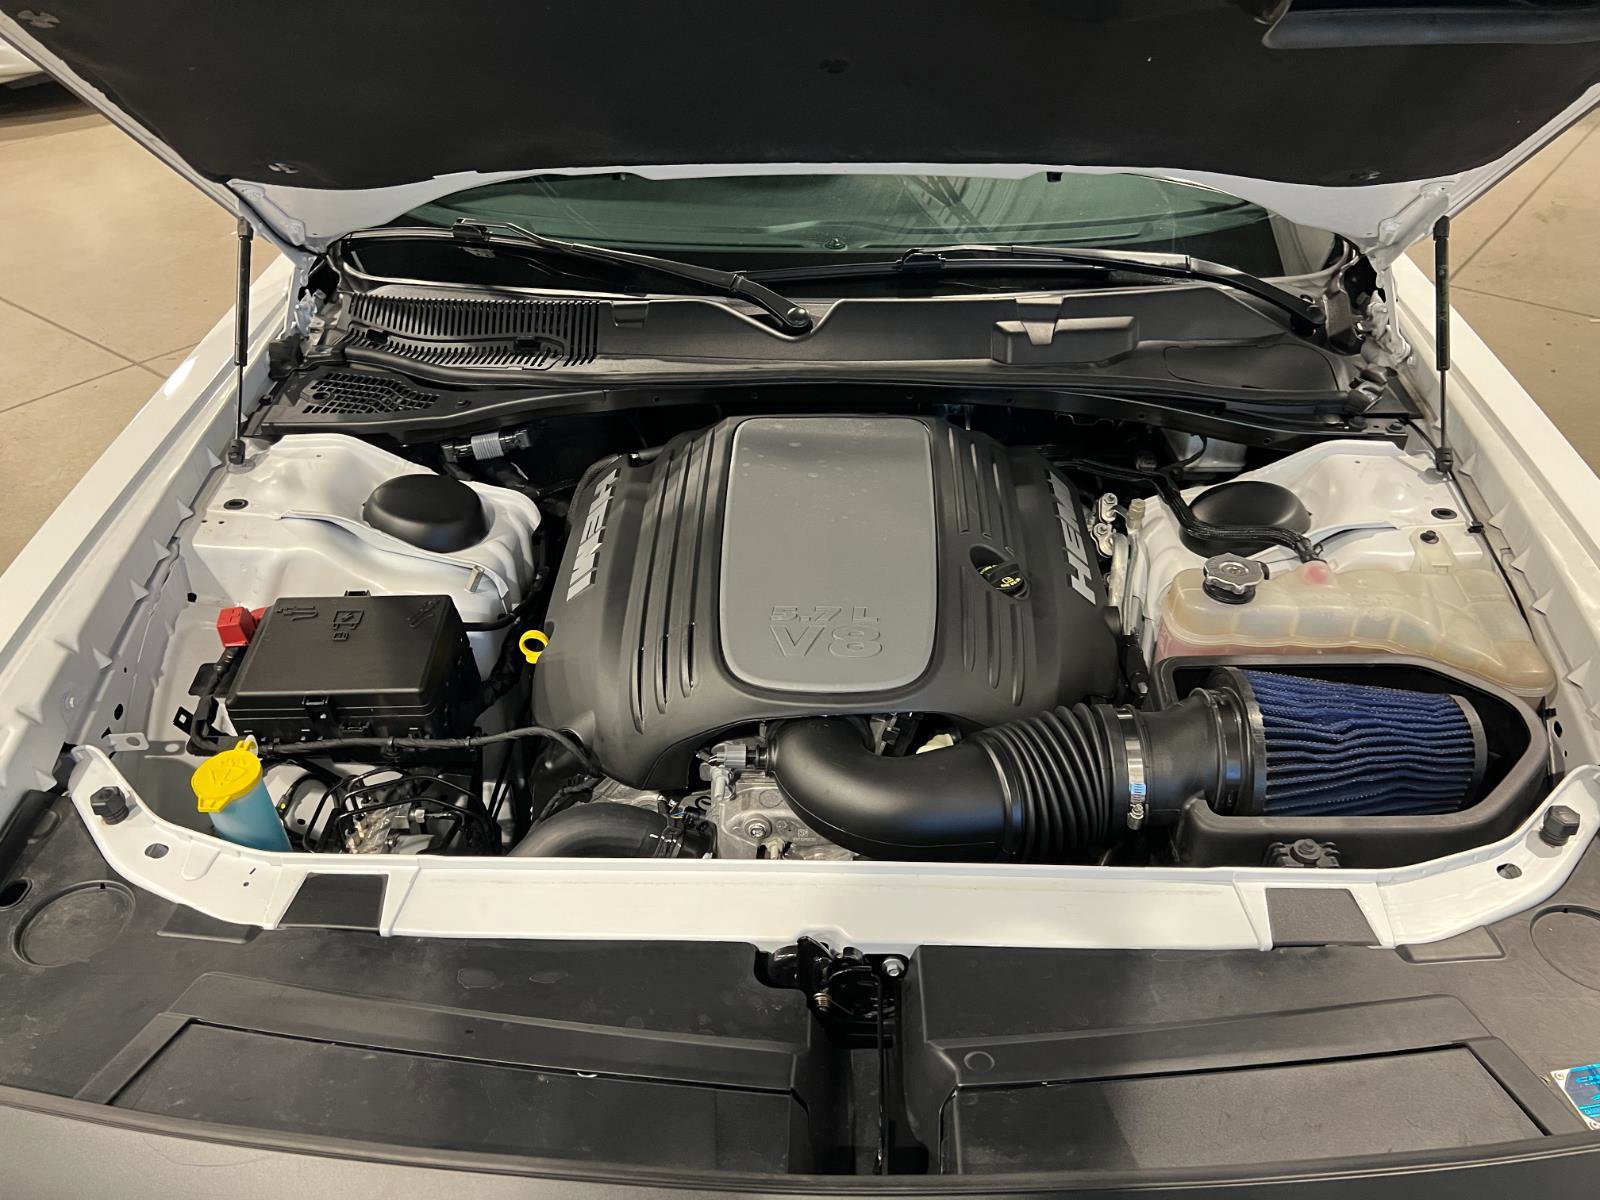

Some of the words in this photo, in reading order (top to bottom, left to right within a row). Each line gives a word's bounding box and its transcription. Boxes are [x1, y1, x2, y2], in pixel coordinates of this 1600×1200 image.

[566, 468, 617, 602] HEMI
[1049, 470, 1096, 605] HEMI
[769, 624, 883, 658] V8
